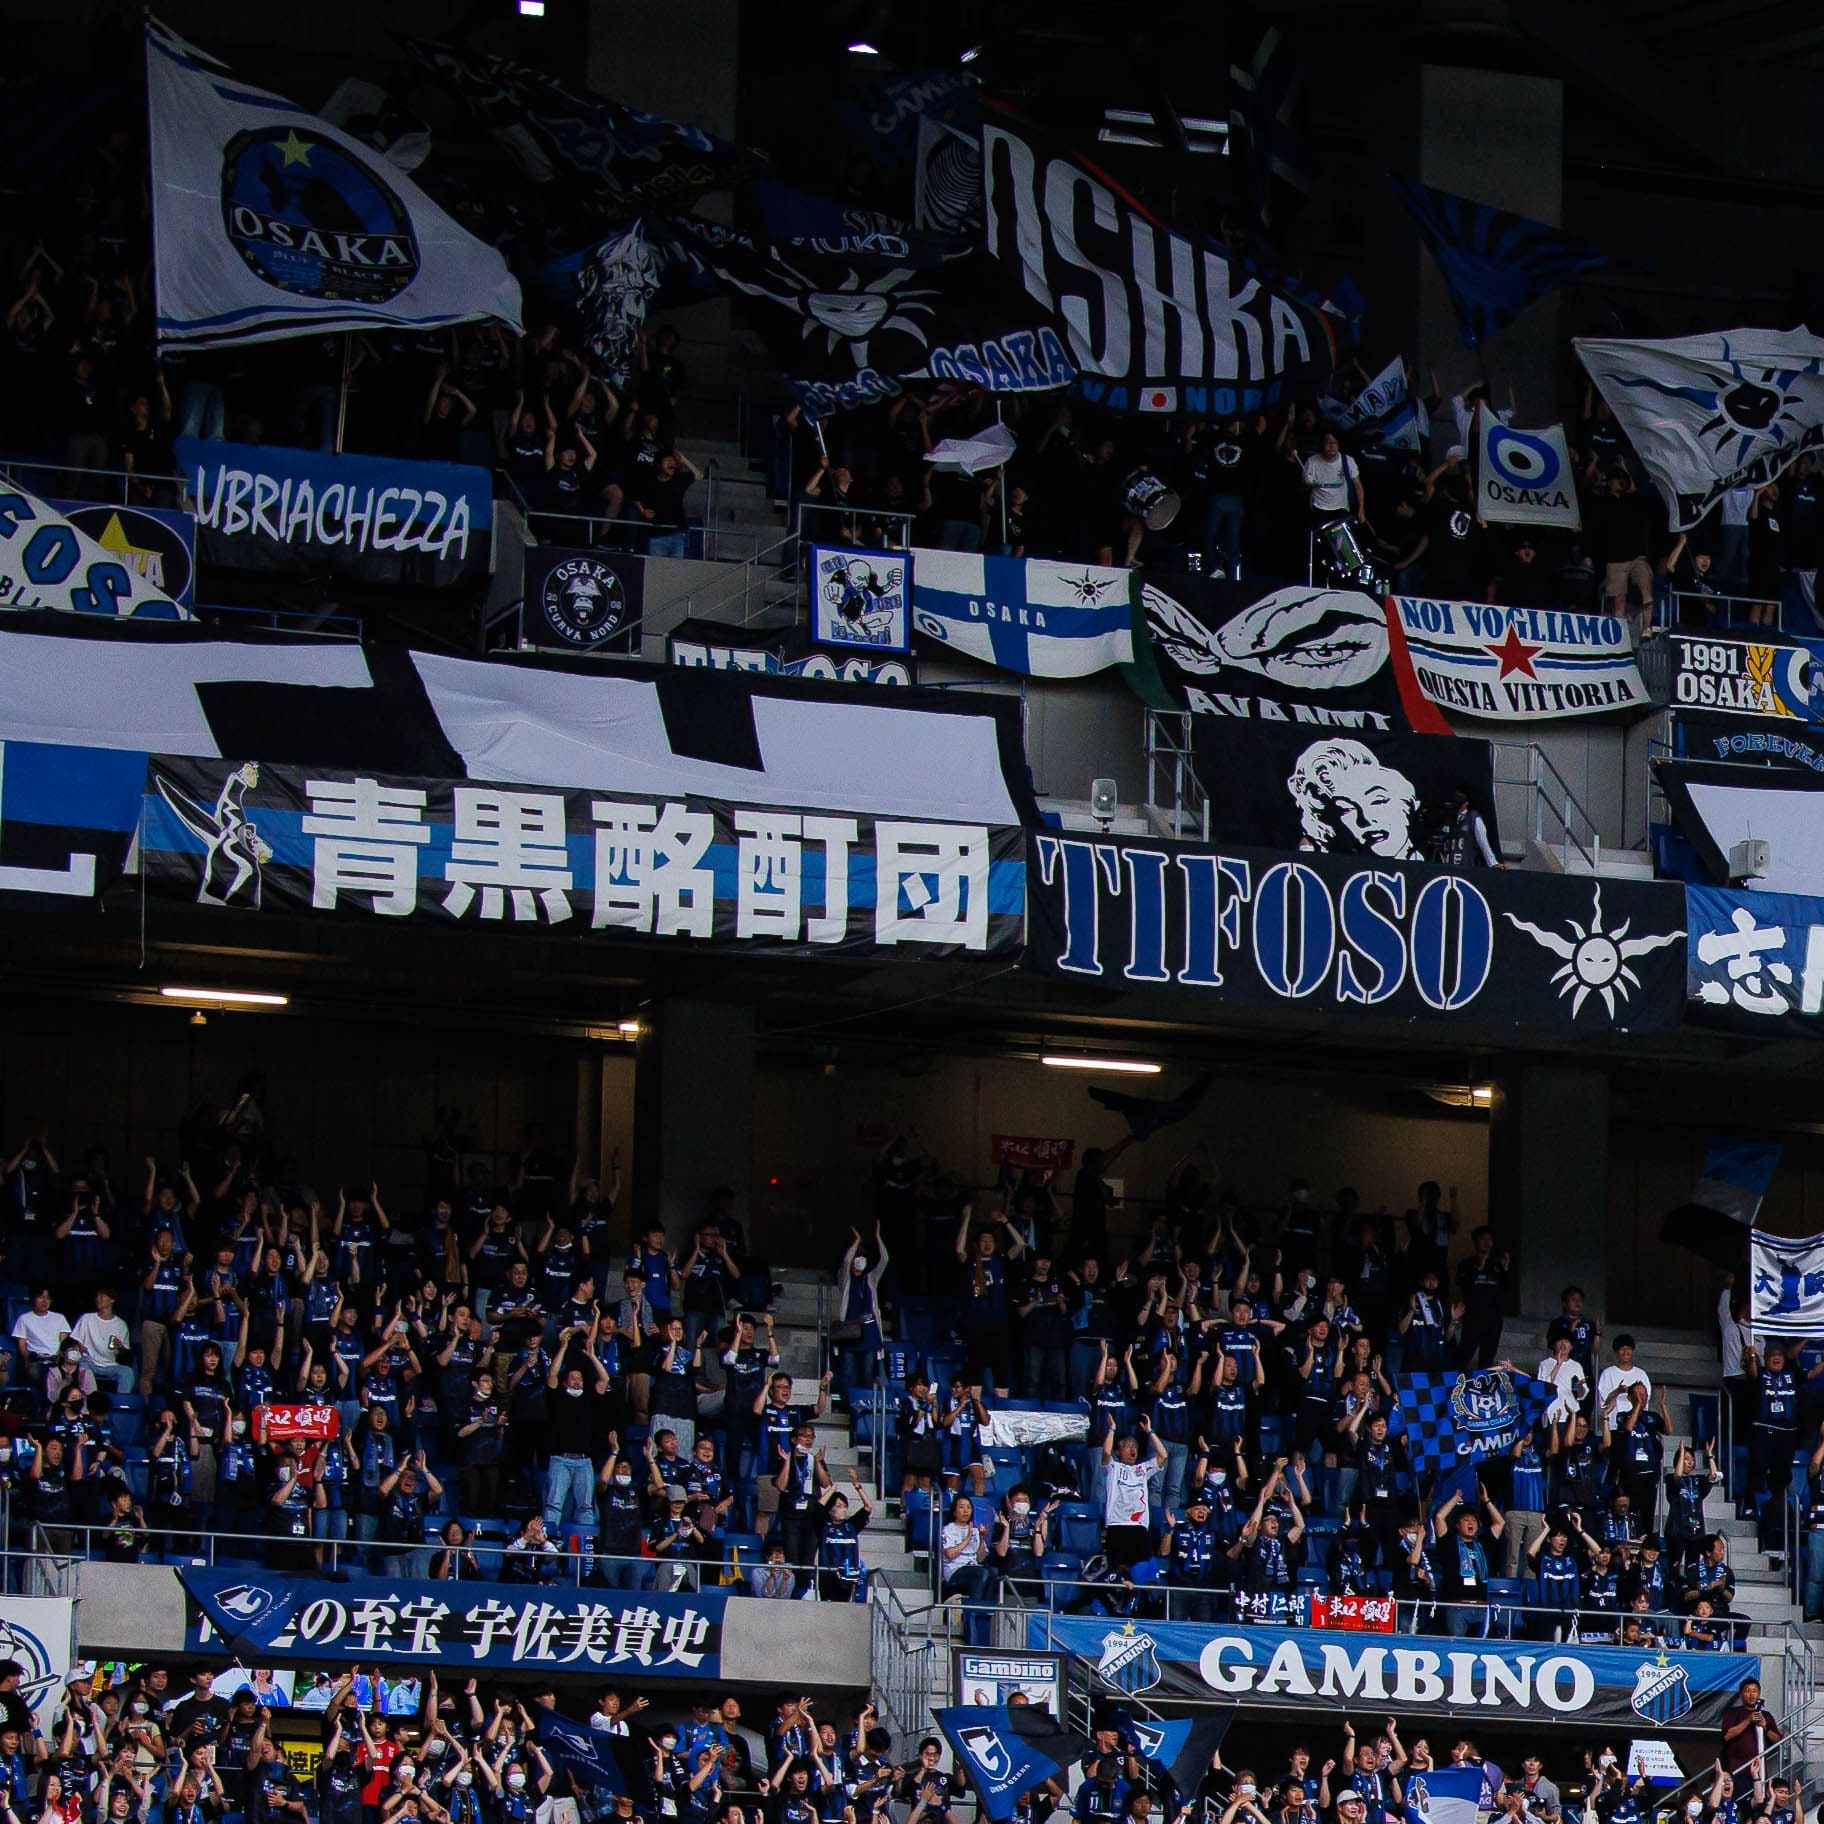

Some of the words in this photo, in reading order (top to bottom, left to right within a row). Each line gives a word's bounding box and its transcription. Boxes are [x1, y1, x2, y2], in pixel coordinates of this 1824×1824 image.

[231, 207, 410, 266] OSAKA
[195, 463, 470, 561] UBRIACHEZZA
[1487, 479, 1570, 509] OSAKA
[555, 560, 617, 590] OSAKA
[968, 600, 1046, 629] OSAKA
[1401, 600, 1456, 640] NOI
[1463, 608, 1622, 648] VOGLIAMO
[1681, 644, 1741, 675] 1991
[1418, 667, 1498, 712] QUESTA
[1502, 679, 1635, 713] VITTORIA
[1677, 676, 1775, 715] OSAKA
[1036, 836, 1494, 1011] TIFOSO
[1698, 907, 1793, 1016] 志
[1236, 1595, 1306, 1615] 中村仁郎
[465, 1598, 709, 1667] 宇佐美貴史
[1108, 1640, 1129, 1650] 1994
[965, 1660, 1053, 1678] Gambino
[1200, 1636, 1594, 1712] GAMBINO
[1641, 1670, 1662, 1679] 1994
[1635, 1670, 1682, 1710] GAMBINO
